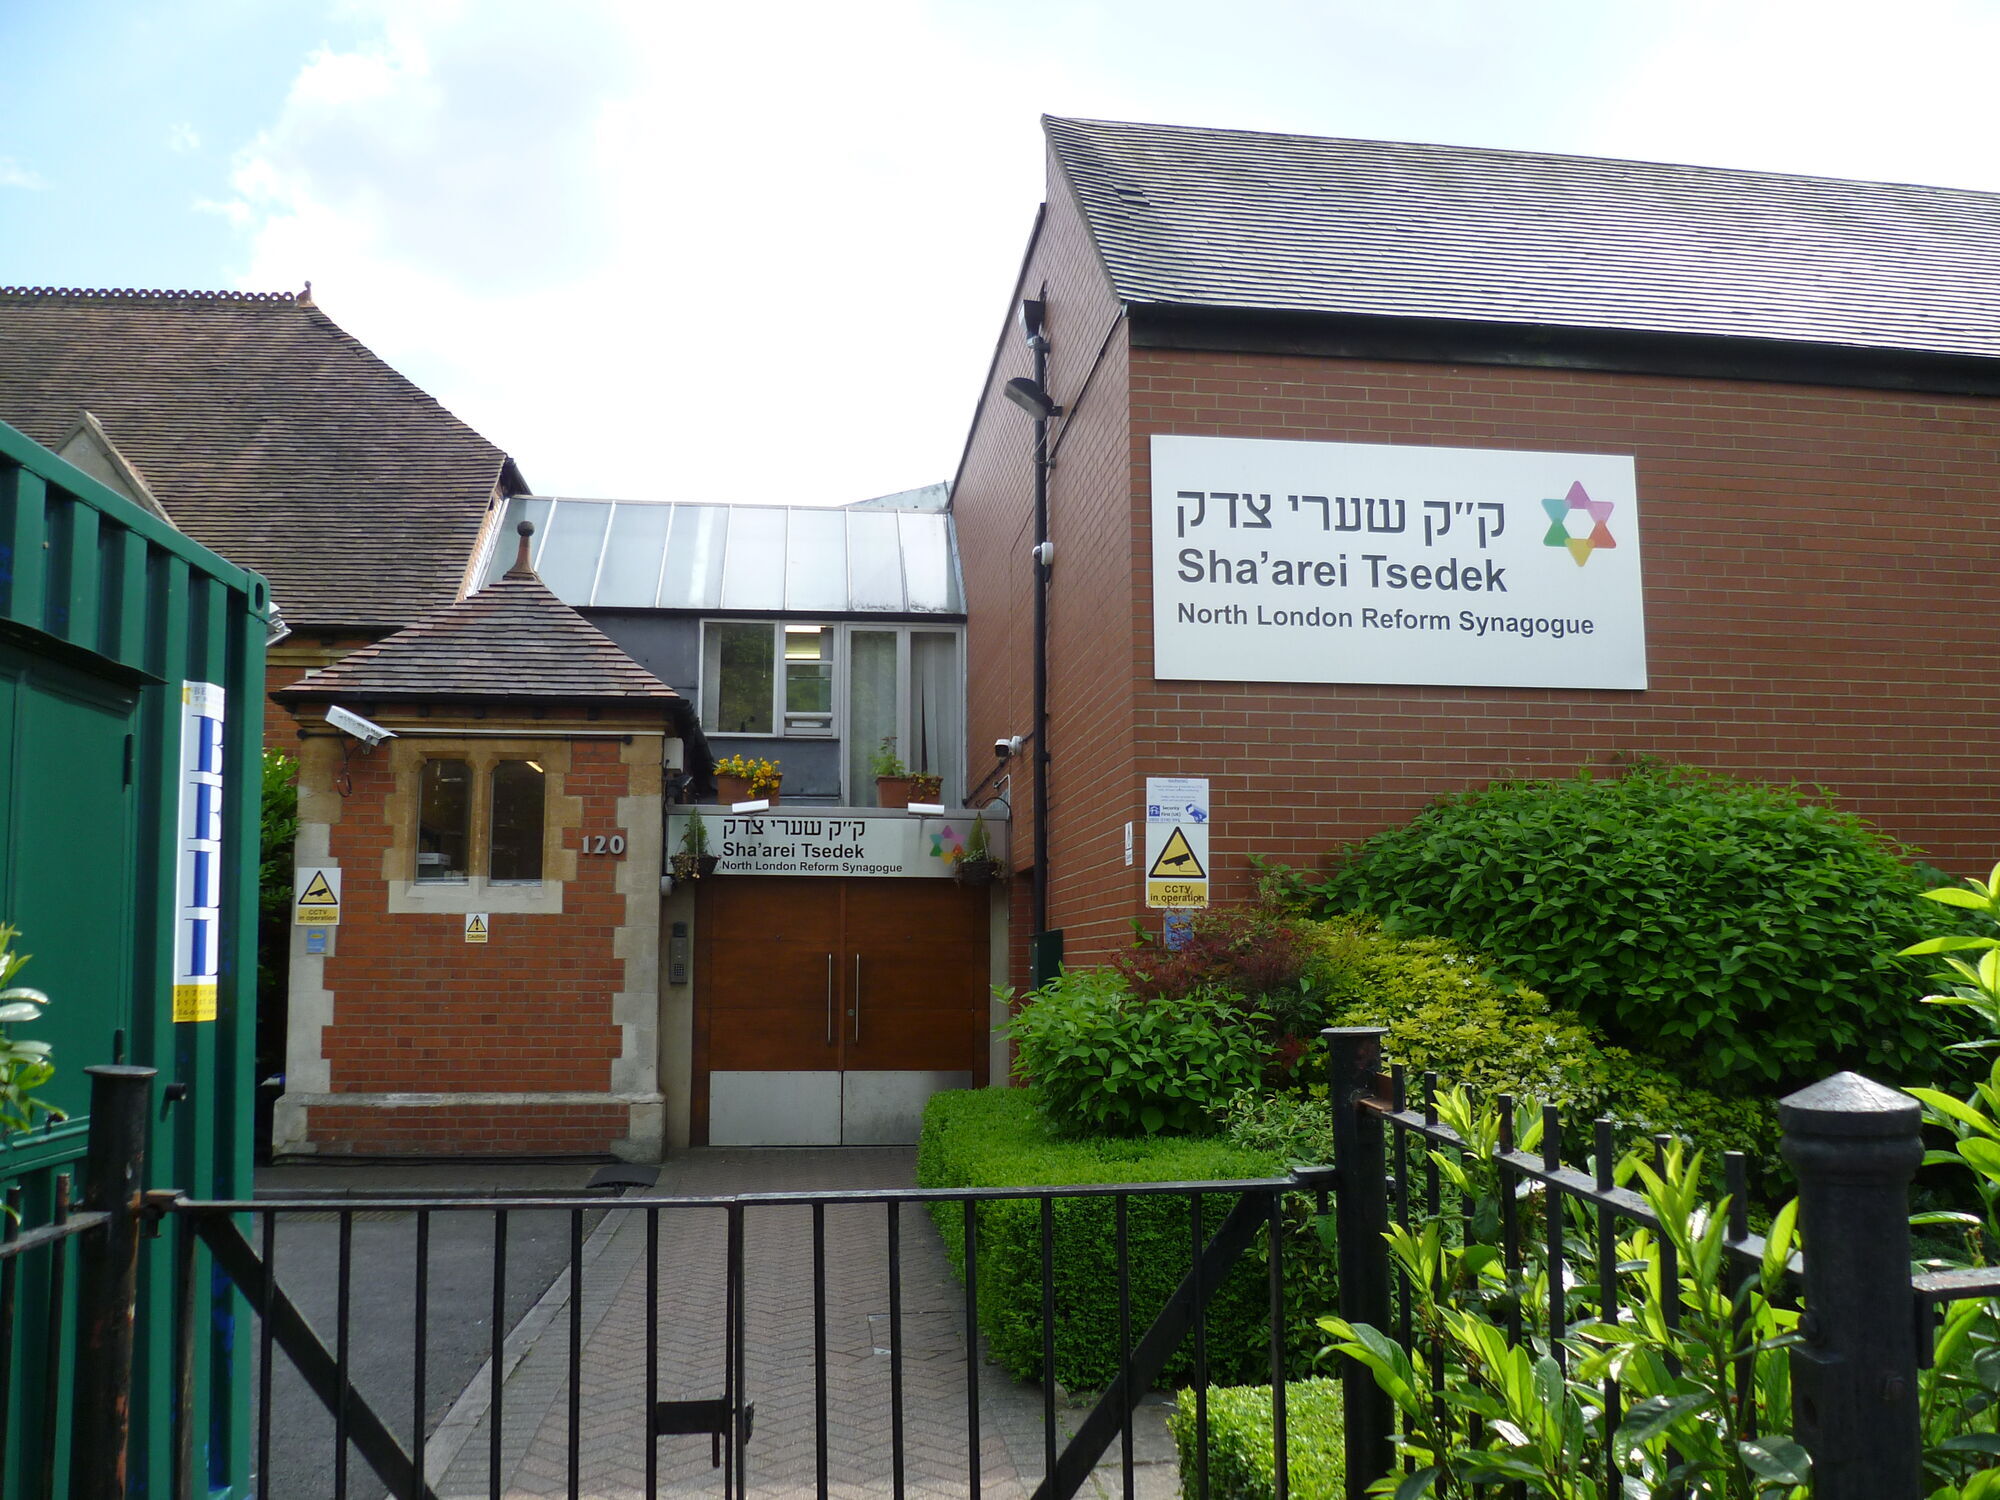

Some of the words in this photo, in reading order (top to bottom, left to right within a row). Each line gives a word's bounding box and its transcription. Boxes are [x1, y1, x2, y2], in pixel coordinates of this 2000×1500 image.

[1176, 490, 1272, 538] צדק
[1287, 495, 1406, 534] שערי
[1177, 548, 1347, 587] Sha'arei
[1361, 554, 1508, 593] Tsedek
[1178, 602, 1248, 625] North
[1257, 605, 1353, 628] London
[1361, 607, 1451, 631] Reform
[1459, 610, 1594, 639] Synagogue
[723, 818, 764, 840] צדק
[770, 819, 822, 836] שערי
[581, 835, 625, 854] 120
[722, 841, 796, 858] Sha'arei
[800, 842, 865, 859] Tsedek
[721, 860, 753, 871] North
[755, 860, 797, 872] London
[799, 861, 839, 872] Reform
[842, 862, 903, 875] Synagogue
[1150, 894, 1159, 902] in
[1161, 893, 1205, 904] operation
[1164, 885, 1191, 894] CCTV
